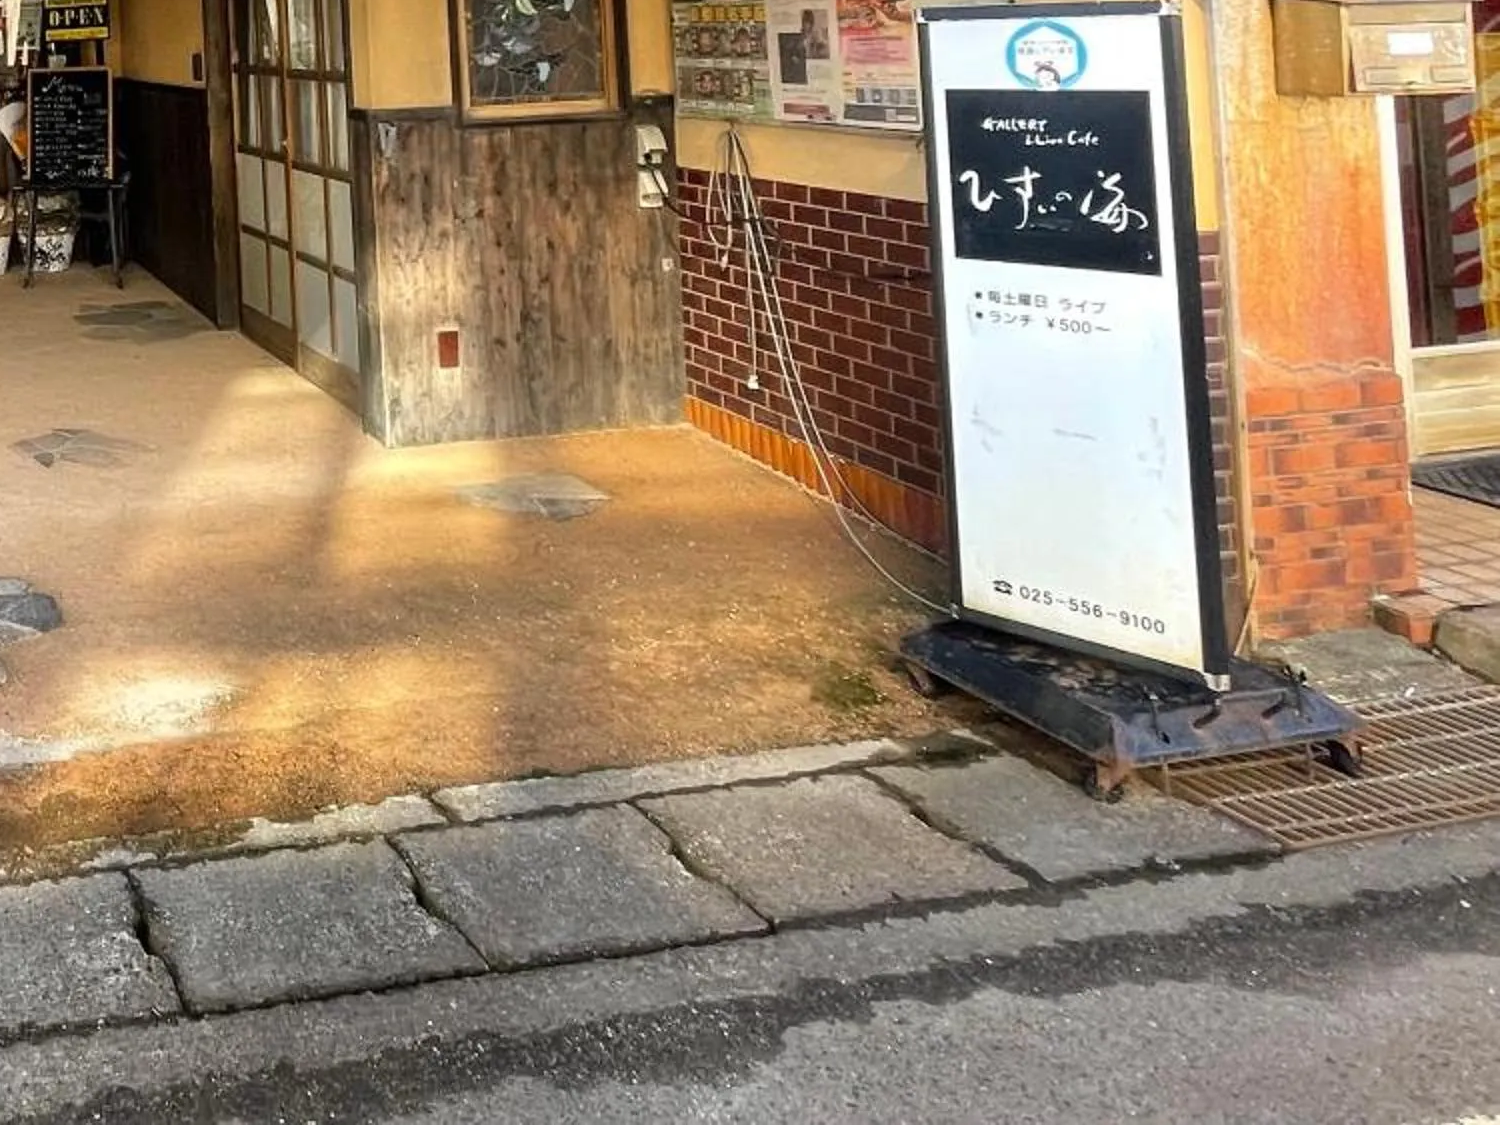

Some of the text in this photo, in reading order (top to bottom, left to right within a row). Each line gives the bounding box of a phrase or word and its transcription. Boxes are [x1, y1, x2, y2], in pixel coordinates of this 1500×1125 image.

[989, 310, 1034, 328] ランチ
[1019, 586, 1165, 634] 025-556-9100
